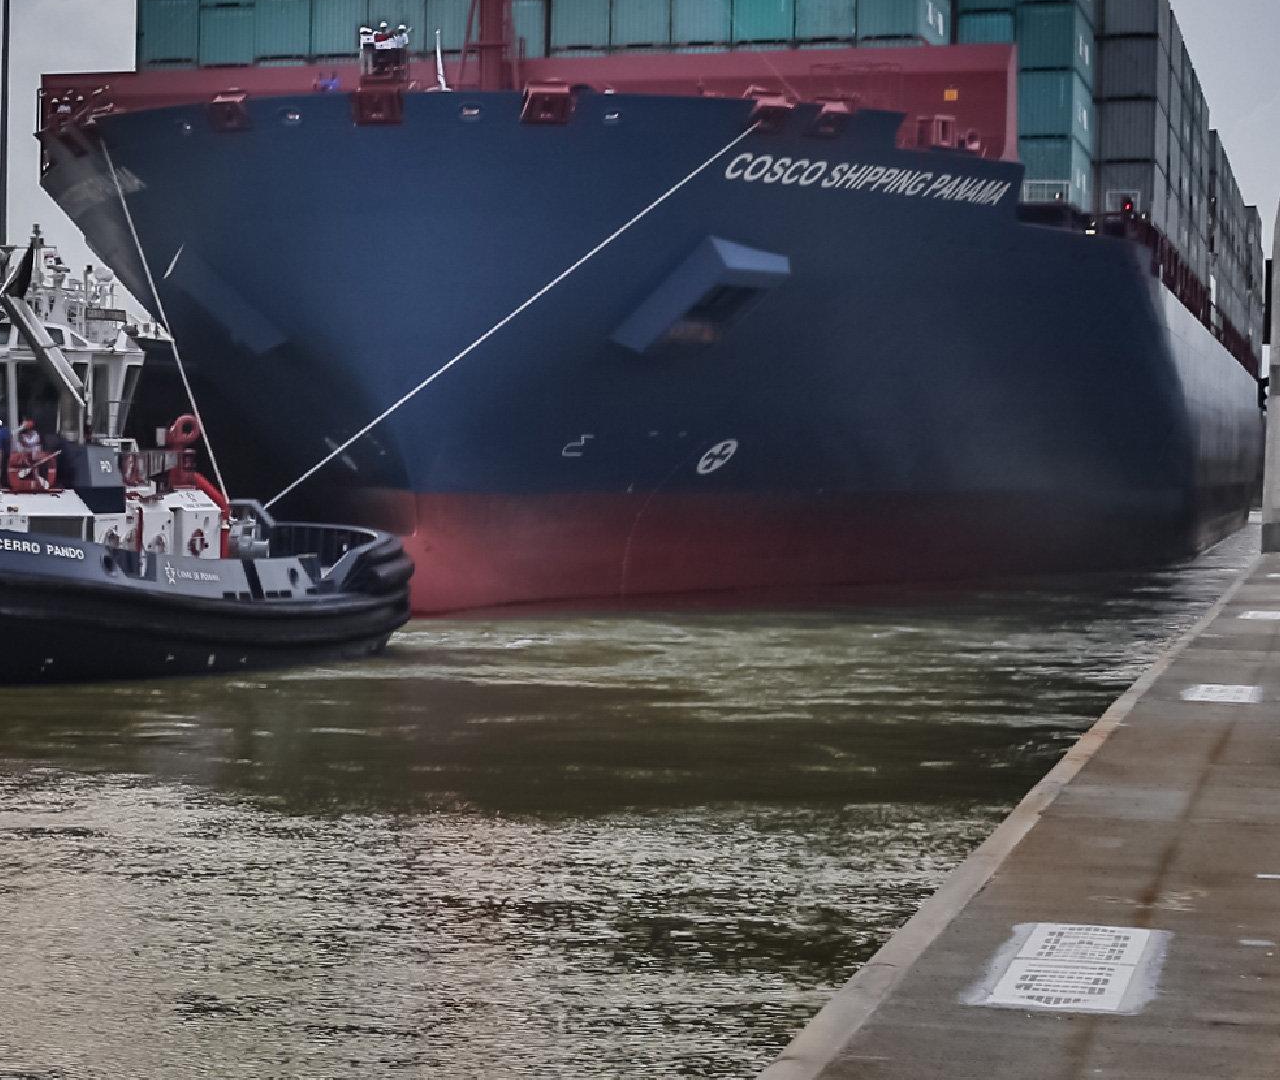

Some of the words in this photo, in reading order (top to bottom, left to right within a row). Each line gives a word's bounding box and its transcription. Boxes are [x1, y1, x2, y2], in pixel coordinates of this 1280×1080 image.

[725, 152, 827, 186] COSCO
[821, 163, 933, 197] SHIPPING
[922, 174, 1011, 206] PANAMA
[46, 544, 85, 560] PANDO
